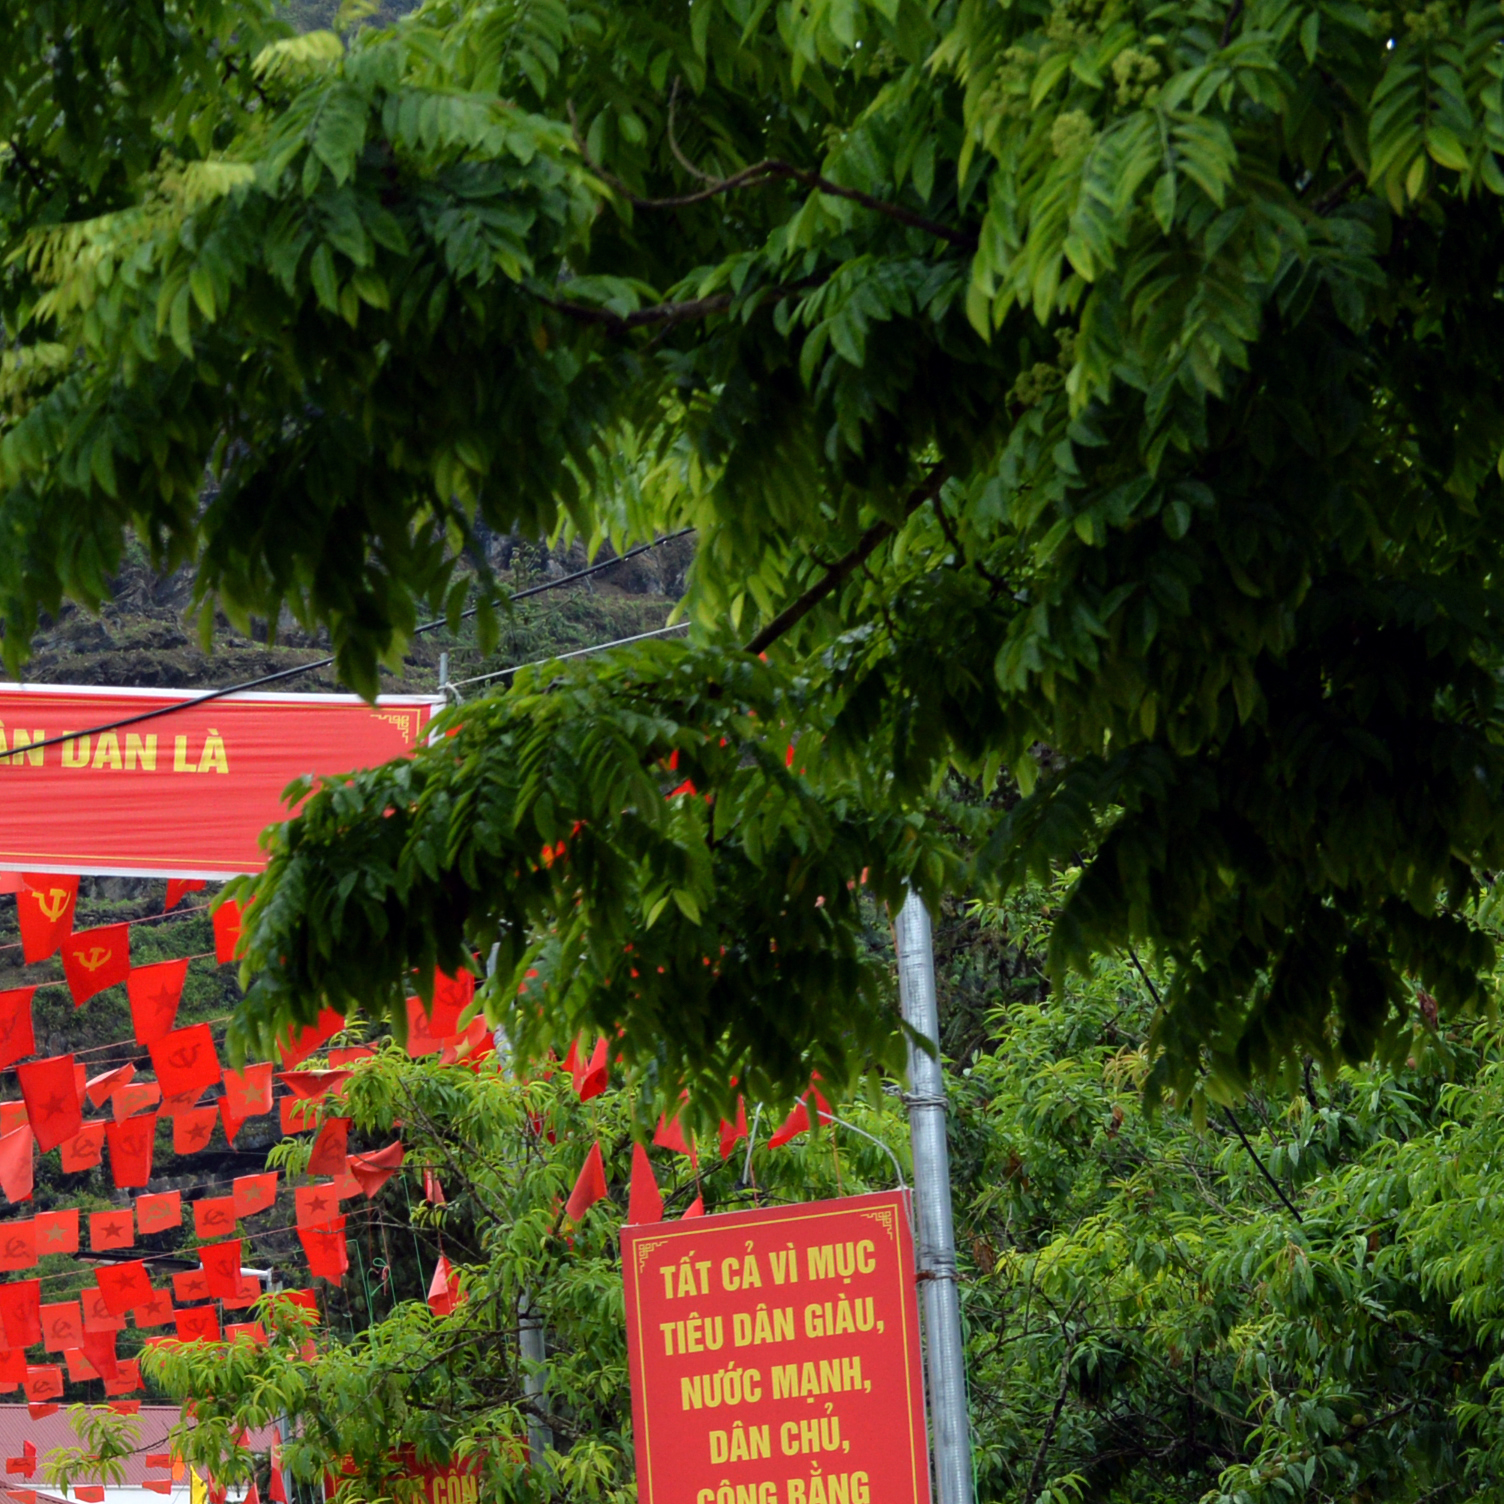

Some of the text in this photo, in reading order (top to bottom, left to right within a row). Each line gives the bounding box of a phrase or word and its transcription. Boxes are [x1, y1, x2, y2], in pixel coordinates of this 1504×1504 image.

[60, 728, 158, 771] DÂN
[173, 728, 230, 774] LÀ
[659, 1239, 877, 1300] TẤT CẢ VÌ MỤC
[659, 1293, 886, 1356] TIÊU DÂN GIÀU,
[680, 1355, 872, 1411] NƯỚC MẠNH,
[709, 1402, 851, 1465] DÂN CHỦ,
